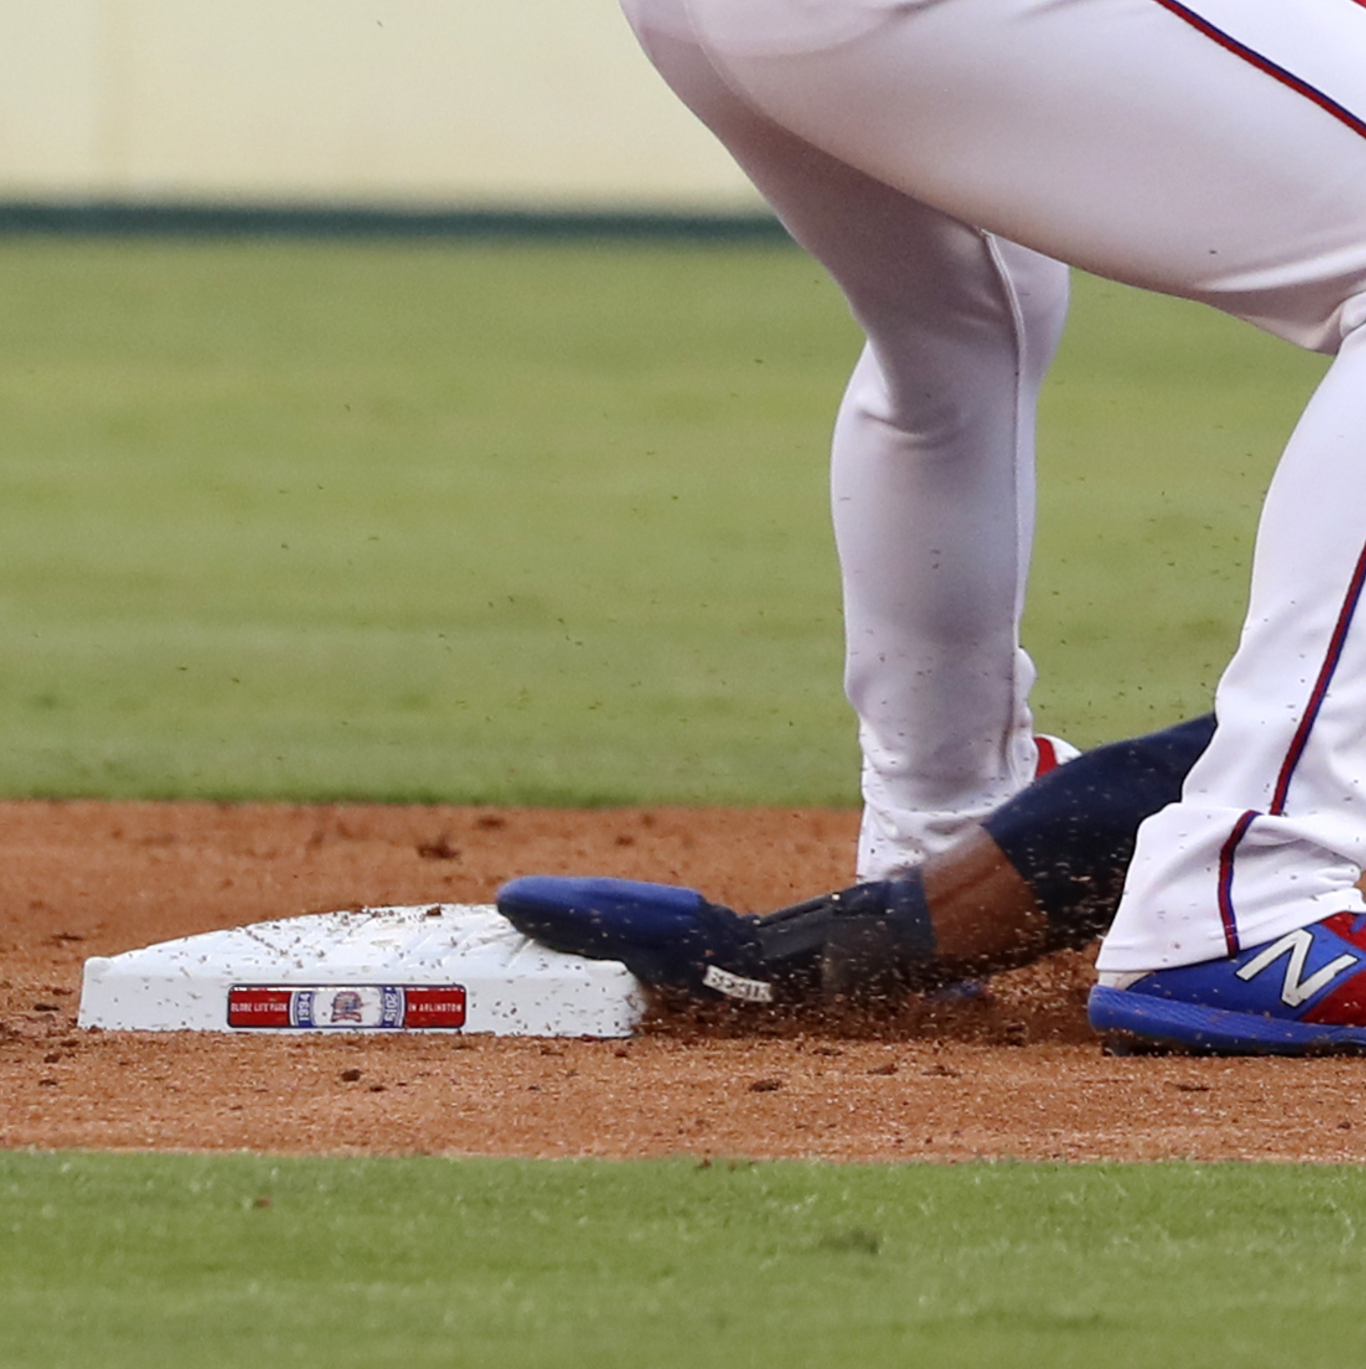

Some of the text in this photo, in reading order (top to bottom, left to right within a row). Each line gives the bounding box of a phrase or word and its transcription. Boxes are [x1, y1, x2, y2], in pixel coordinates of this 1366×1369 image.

[1235, 927, 1360, 1009] N
[298, 992, 312, 1022] 1994
[408, 1002, 463, 1013] IN ARLINGTON
